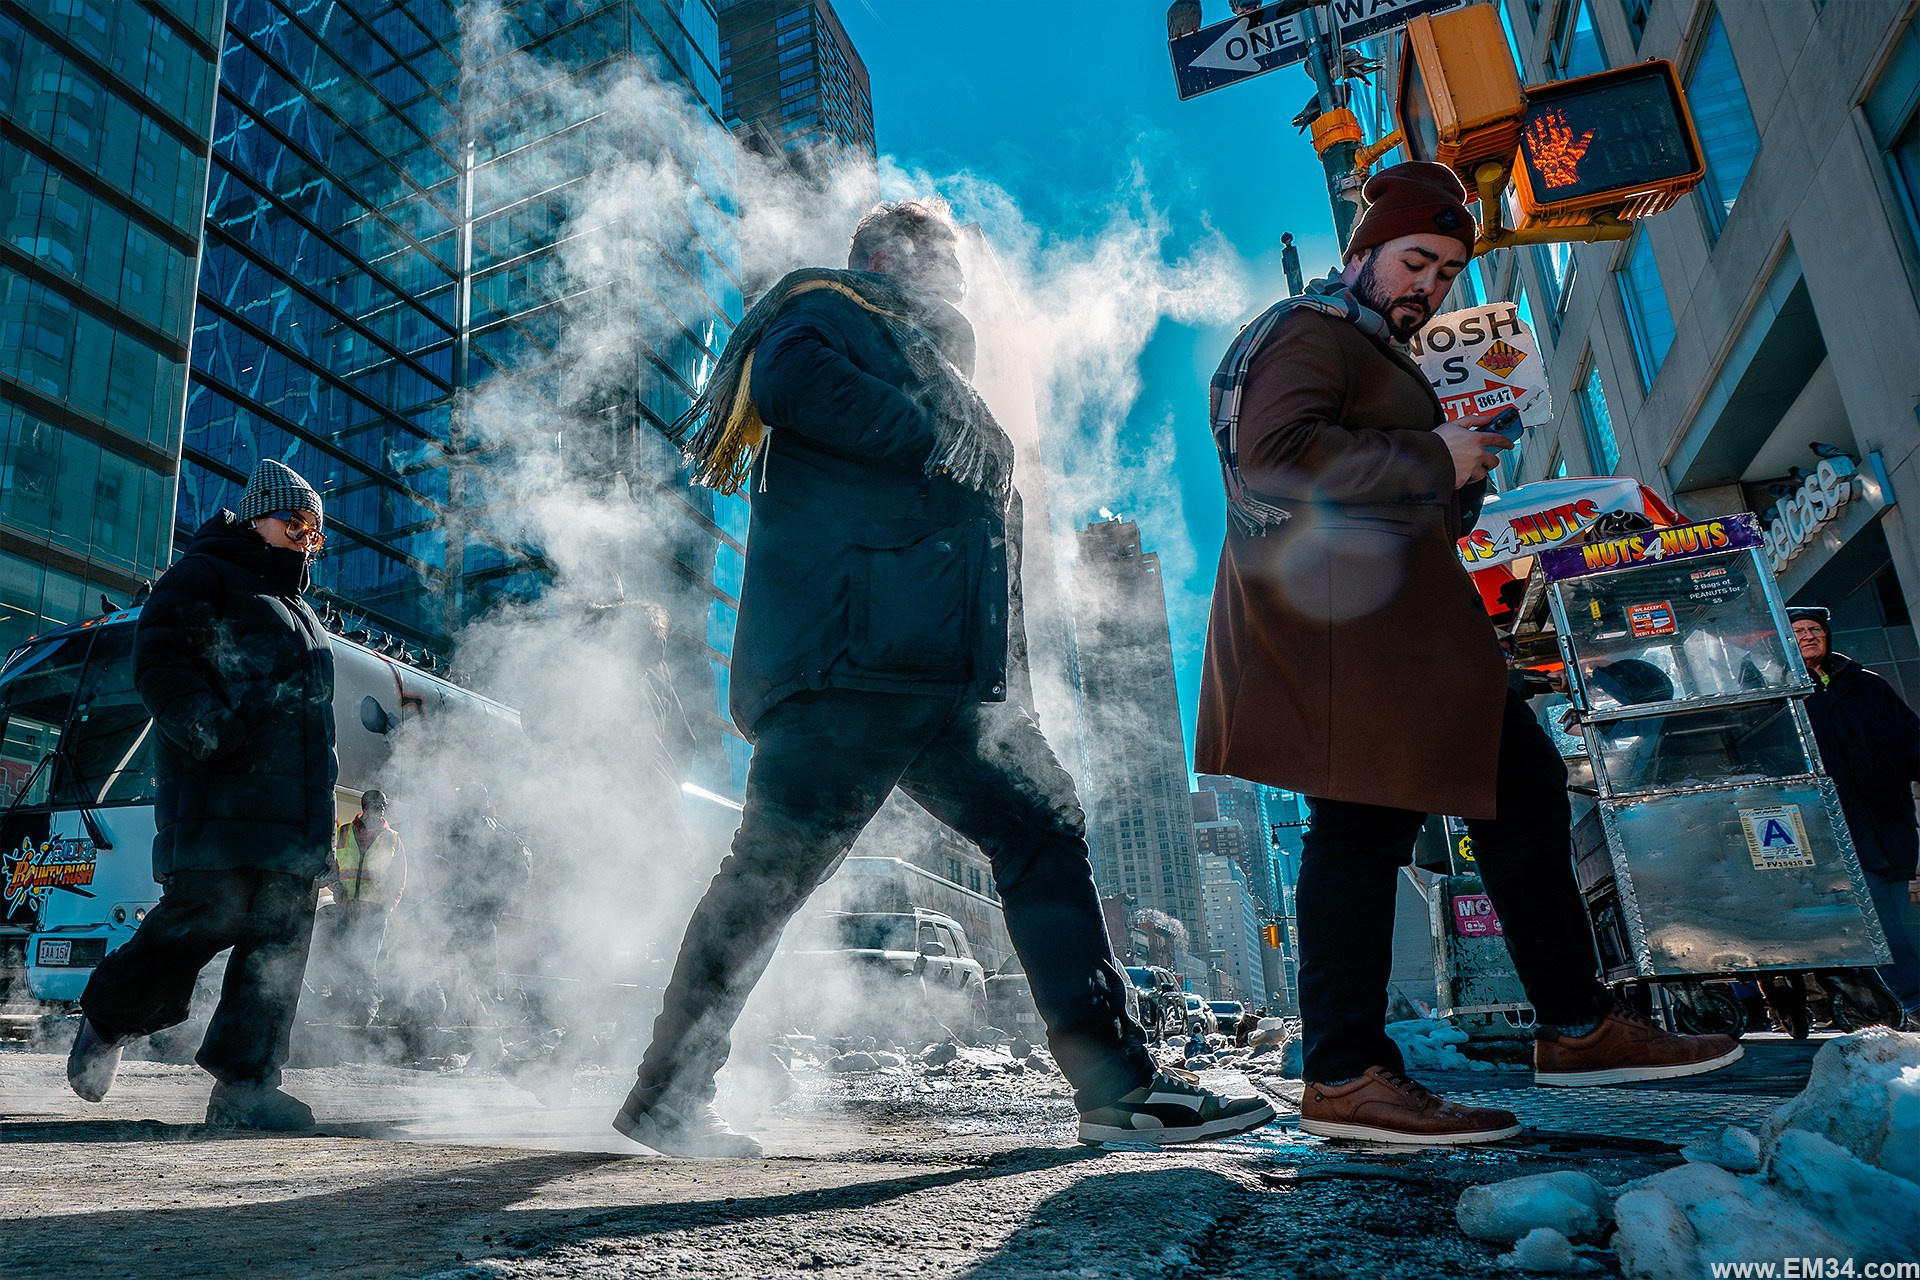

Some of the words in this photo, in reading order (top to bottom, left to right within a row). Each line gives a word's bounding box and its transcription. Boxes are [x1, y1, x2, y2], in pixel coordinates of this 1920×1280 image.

[1225, 19, 1299, 61] ONE
[1477, 389, 1512, 408] 8647
[1689, 587, 1728, 600] PEANUTS
[1700, 580, 1721, 590] Bags
[1722, 578, 1731, 586] of
[1763, 818, 1795, 847] A
[62, 863, 95, 885] RUSH
